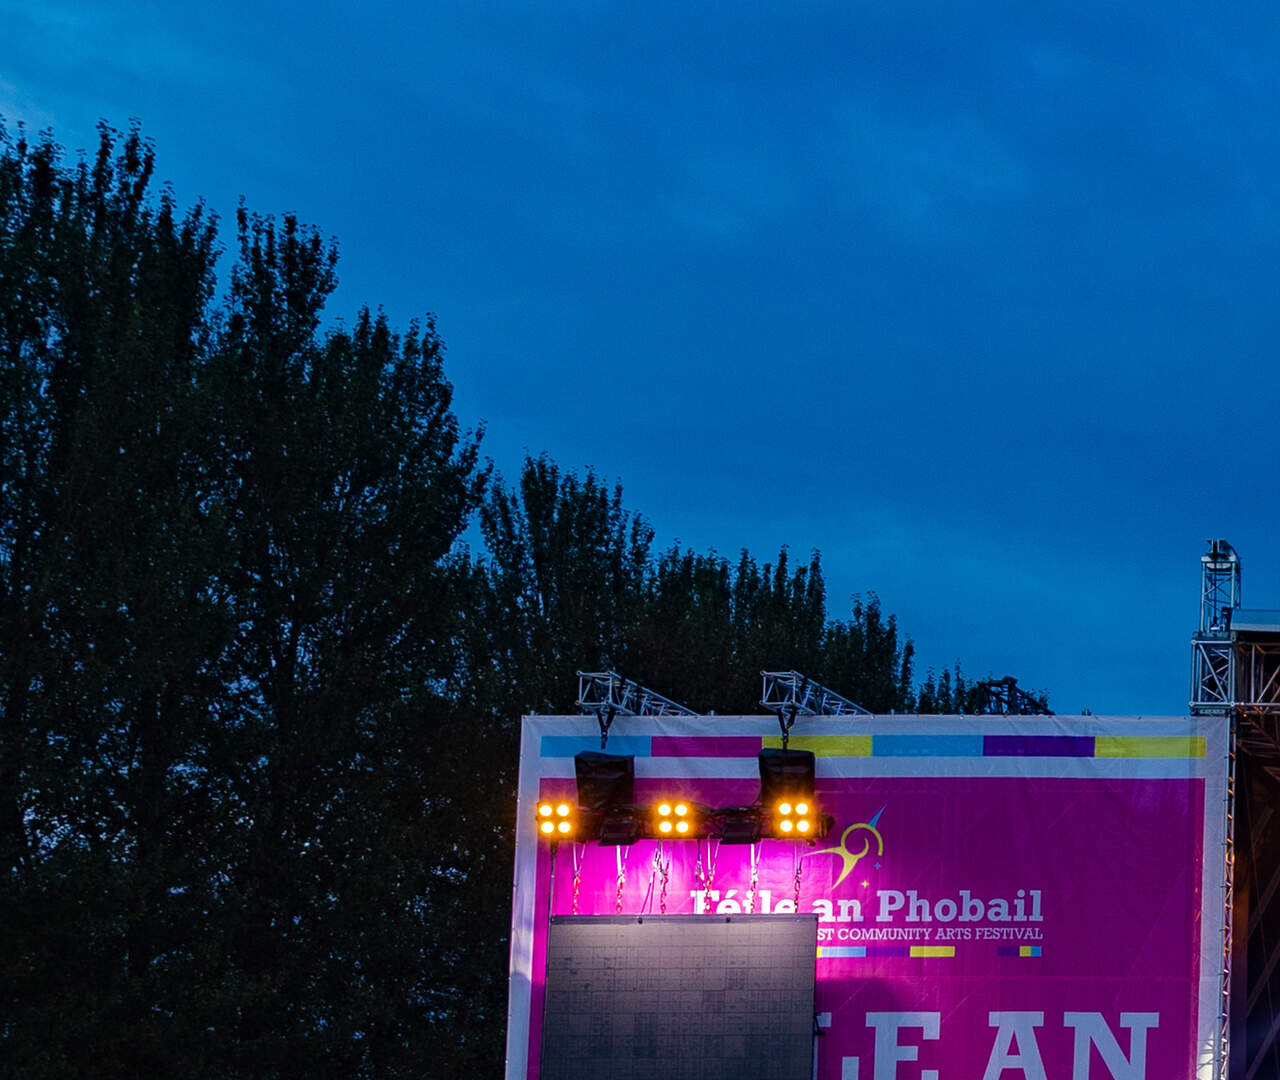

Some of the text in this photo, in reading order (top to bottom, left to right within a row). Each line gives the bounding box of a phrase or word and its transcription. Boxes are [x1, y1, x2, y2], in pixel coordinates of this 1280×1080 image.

[811, 899, 864, 922] an
[876, 889, 1043, 922] Phobail
[837, 927, 932, 941] COMMUNITY
[935, 927, 972, 941] ARTS
[975, 927, 1044, 941] FESTIVAL
